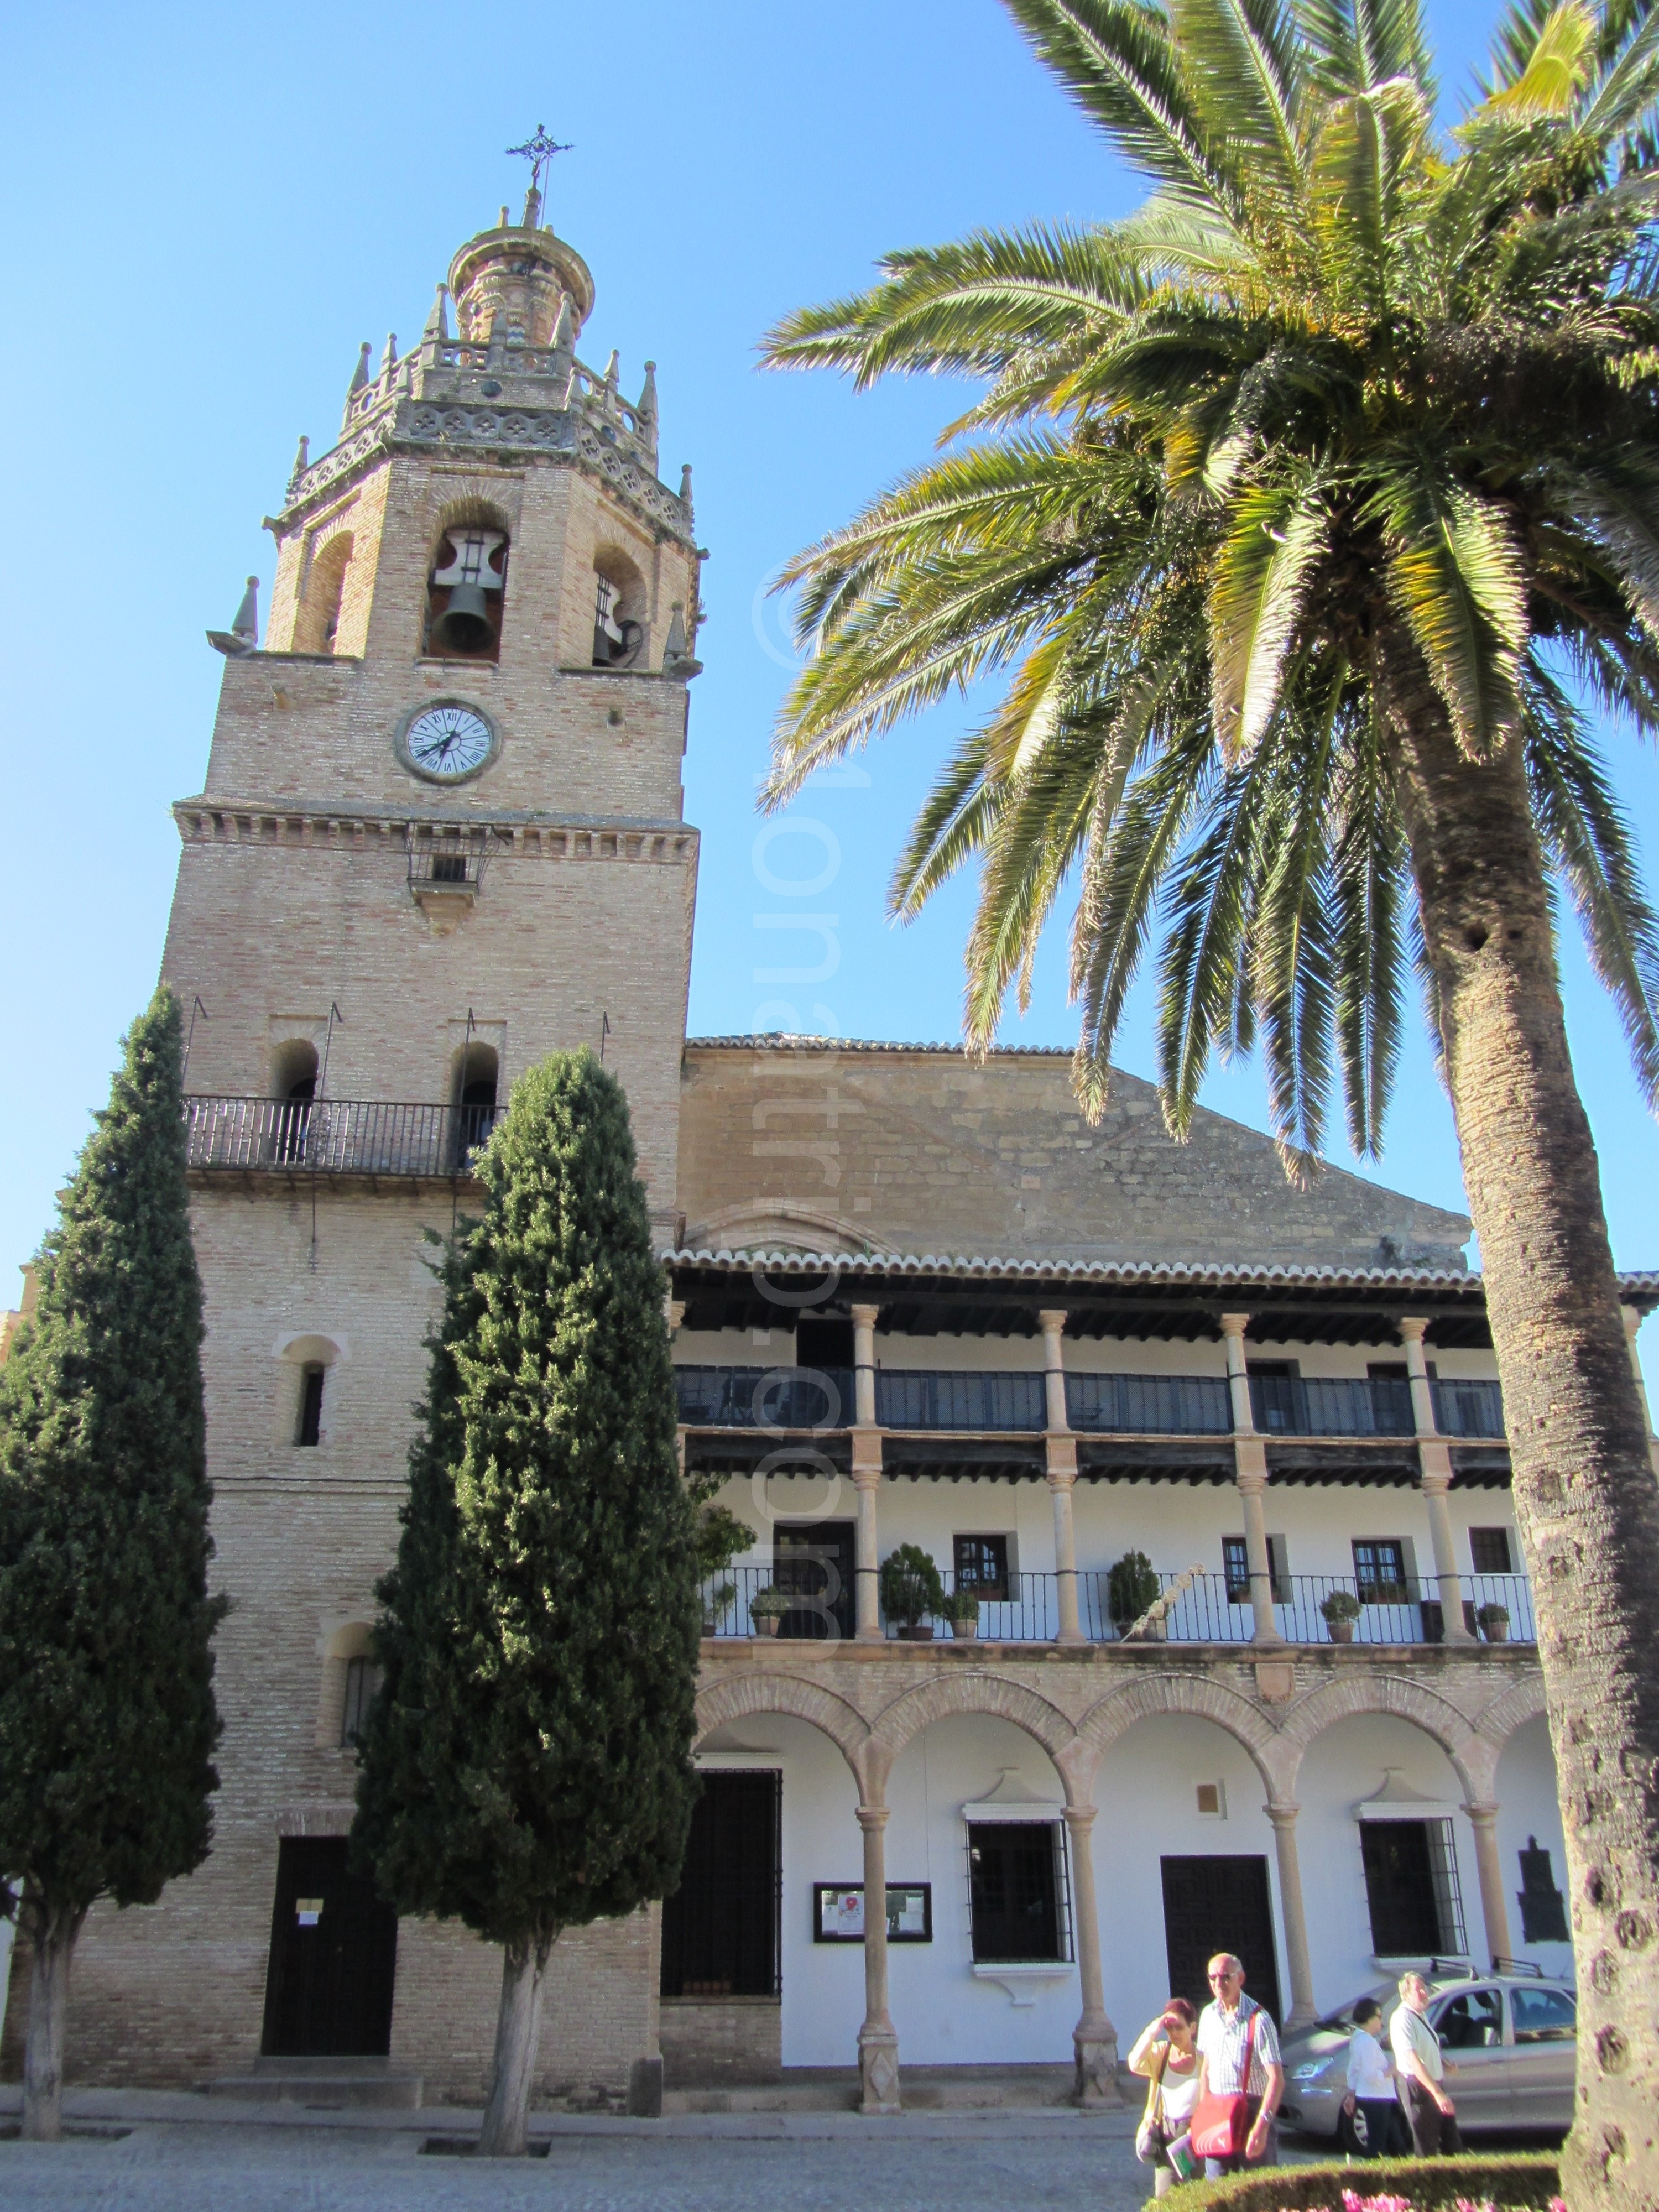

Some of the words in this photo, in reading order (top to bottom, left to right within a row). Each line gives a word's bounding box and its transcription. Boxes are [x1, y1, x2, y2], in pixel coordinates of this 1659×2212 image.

[432, 714, 441, 724] XI
[447, 712, 457, 721] XII
[469, 752, 482, 761] IIII
[426, 758, 437, 769] VII
[444, 763, 451, 771] VI
[461, 761, 467, 769] V
